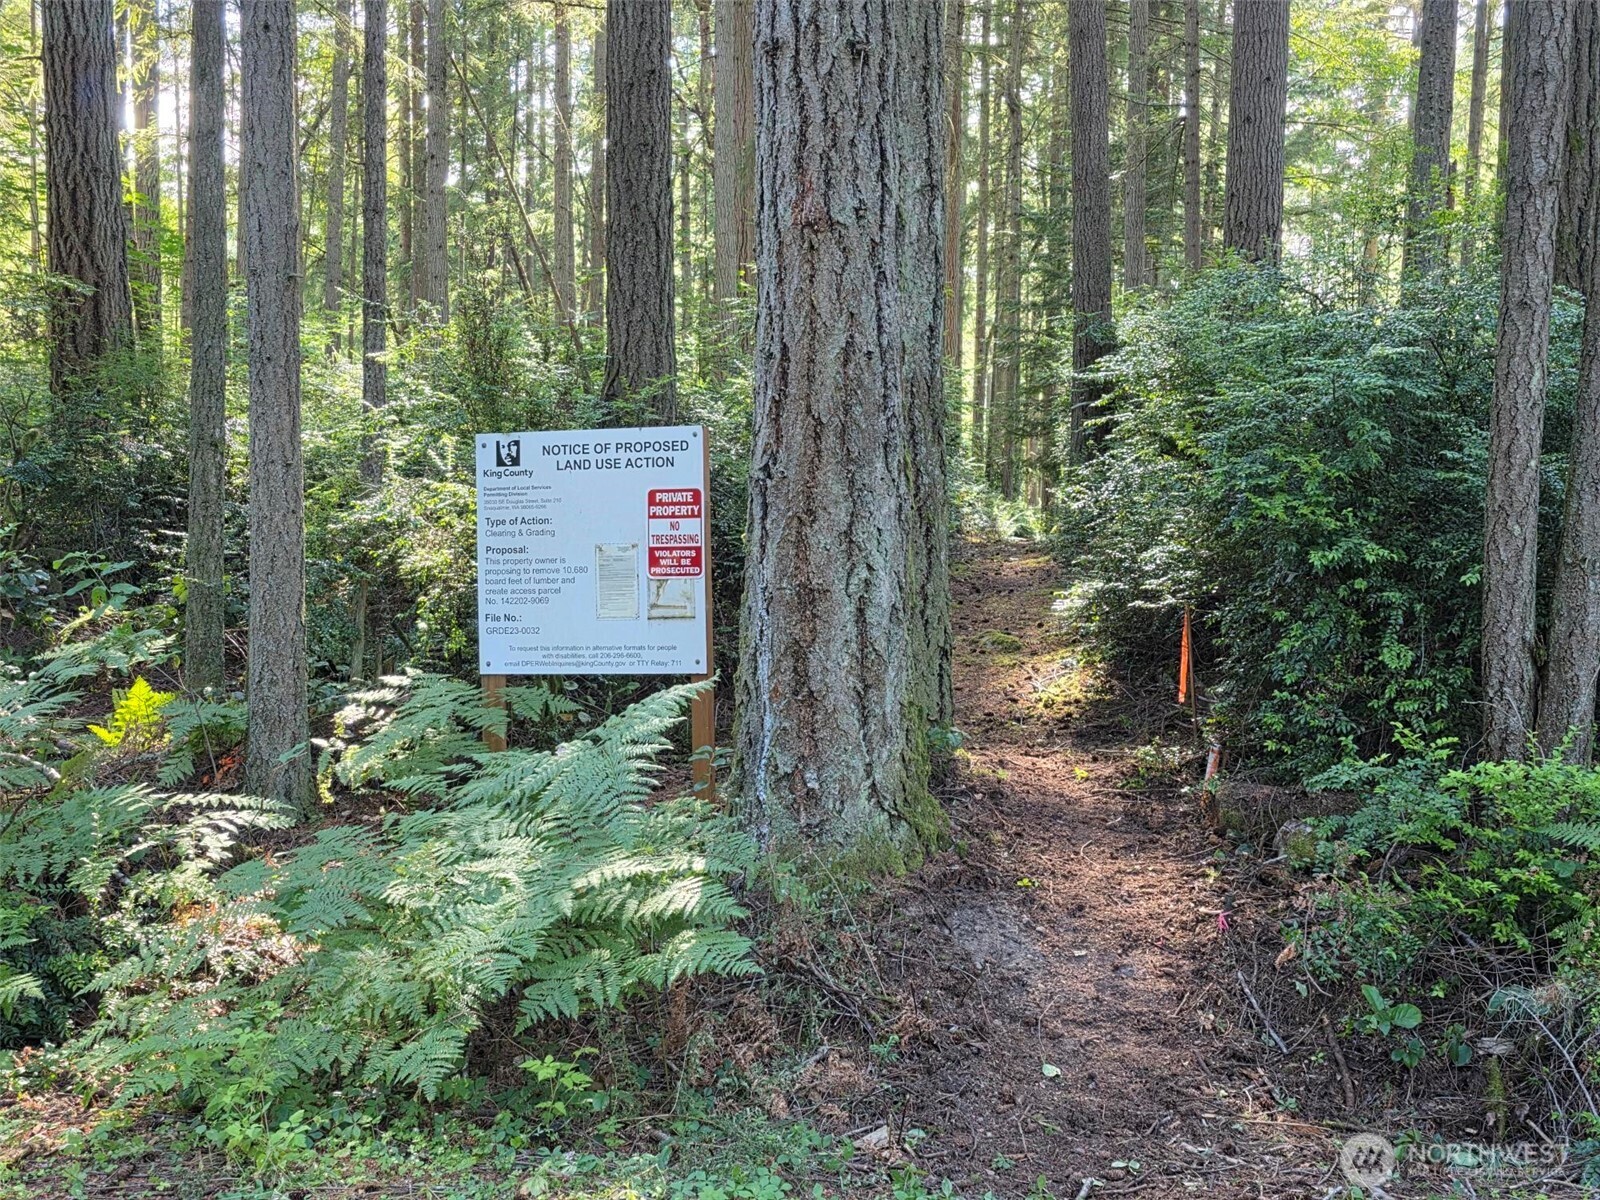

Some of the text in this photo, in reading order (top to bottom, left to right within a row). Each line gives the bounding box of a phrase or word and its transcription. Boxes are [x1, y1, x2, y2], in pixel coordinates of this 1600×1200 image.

[542, 440, 689, 456] NOTICE OF PROPOSED
[556, 457, 675, 471] LAND USE ACTION
[656, 492, 693, 502] PRIVATE
[650, 505, 699, 516] PROPERTY
[485, 516, 553, 528] Type of Action:
[669, 521, 680, 531] NO
[485, 529, 516, 538] Clearing
[526, 529, 556, 537] Grading
[651, 534, 699, 544] TRESPASSING
[485, 545, 529, 555] Proposal:
[502, 557, 533, 566] property
[485, 567, 521, 576] proposing
[485, 577, 506, 585] board
[508, 577, 522, 585] feet
[533, 576, 559, 584] lumber
[561, 576, 576, 584] and
[485, 587, 508, 595] create
[538, 587, 561, 597] parcel
[485, 596, 549, 605] No. 142202-9069
[485, 614, 522, 622] File No.:
[485, 627, 540, 635] GRDE23-0032
